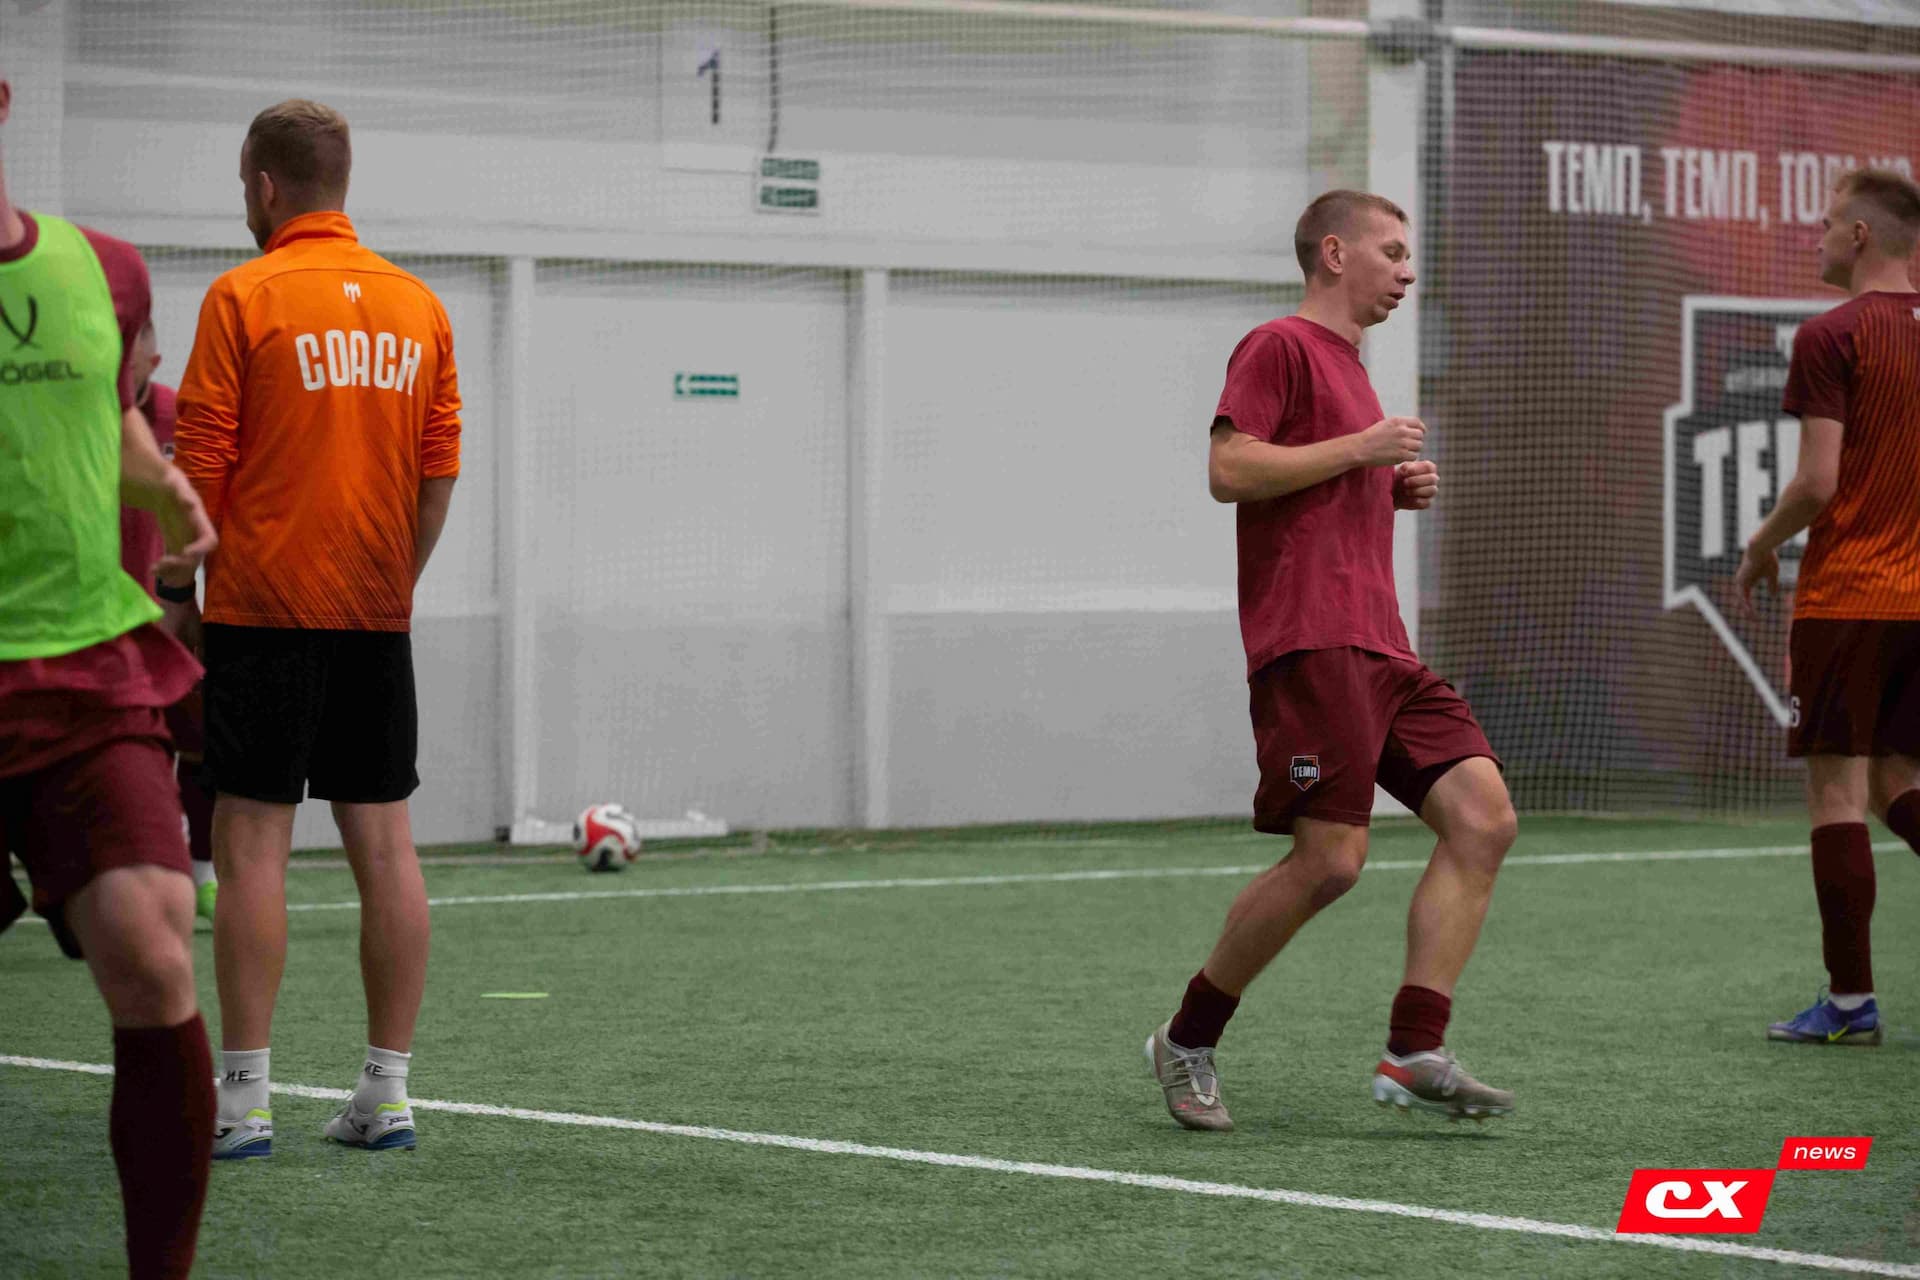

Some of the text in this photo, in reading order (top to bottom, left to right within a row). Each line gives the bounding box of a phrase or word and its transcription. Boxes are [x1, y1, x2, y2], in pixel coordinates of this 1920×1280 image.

[1543, 142, 1654, 224] ТЕМП,
[1661, 147, 1767, 230] ТЕМП,
[295, 329, 423, 397] COACH
[1790, 695, 1802, 728] 6
[1293, 766, 1317, 777] ТЕМП
